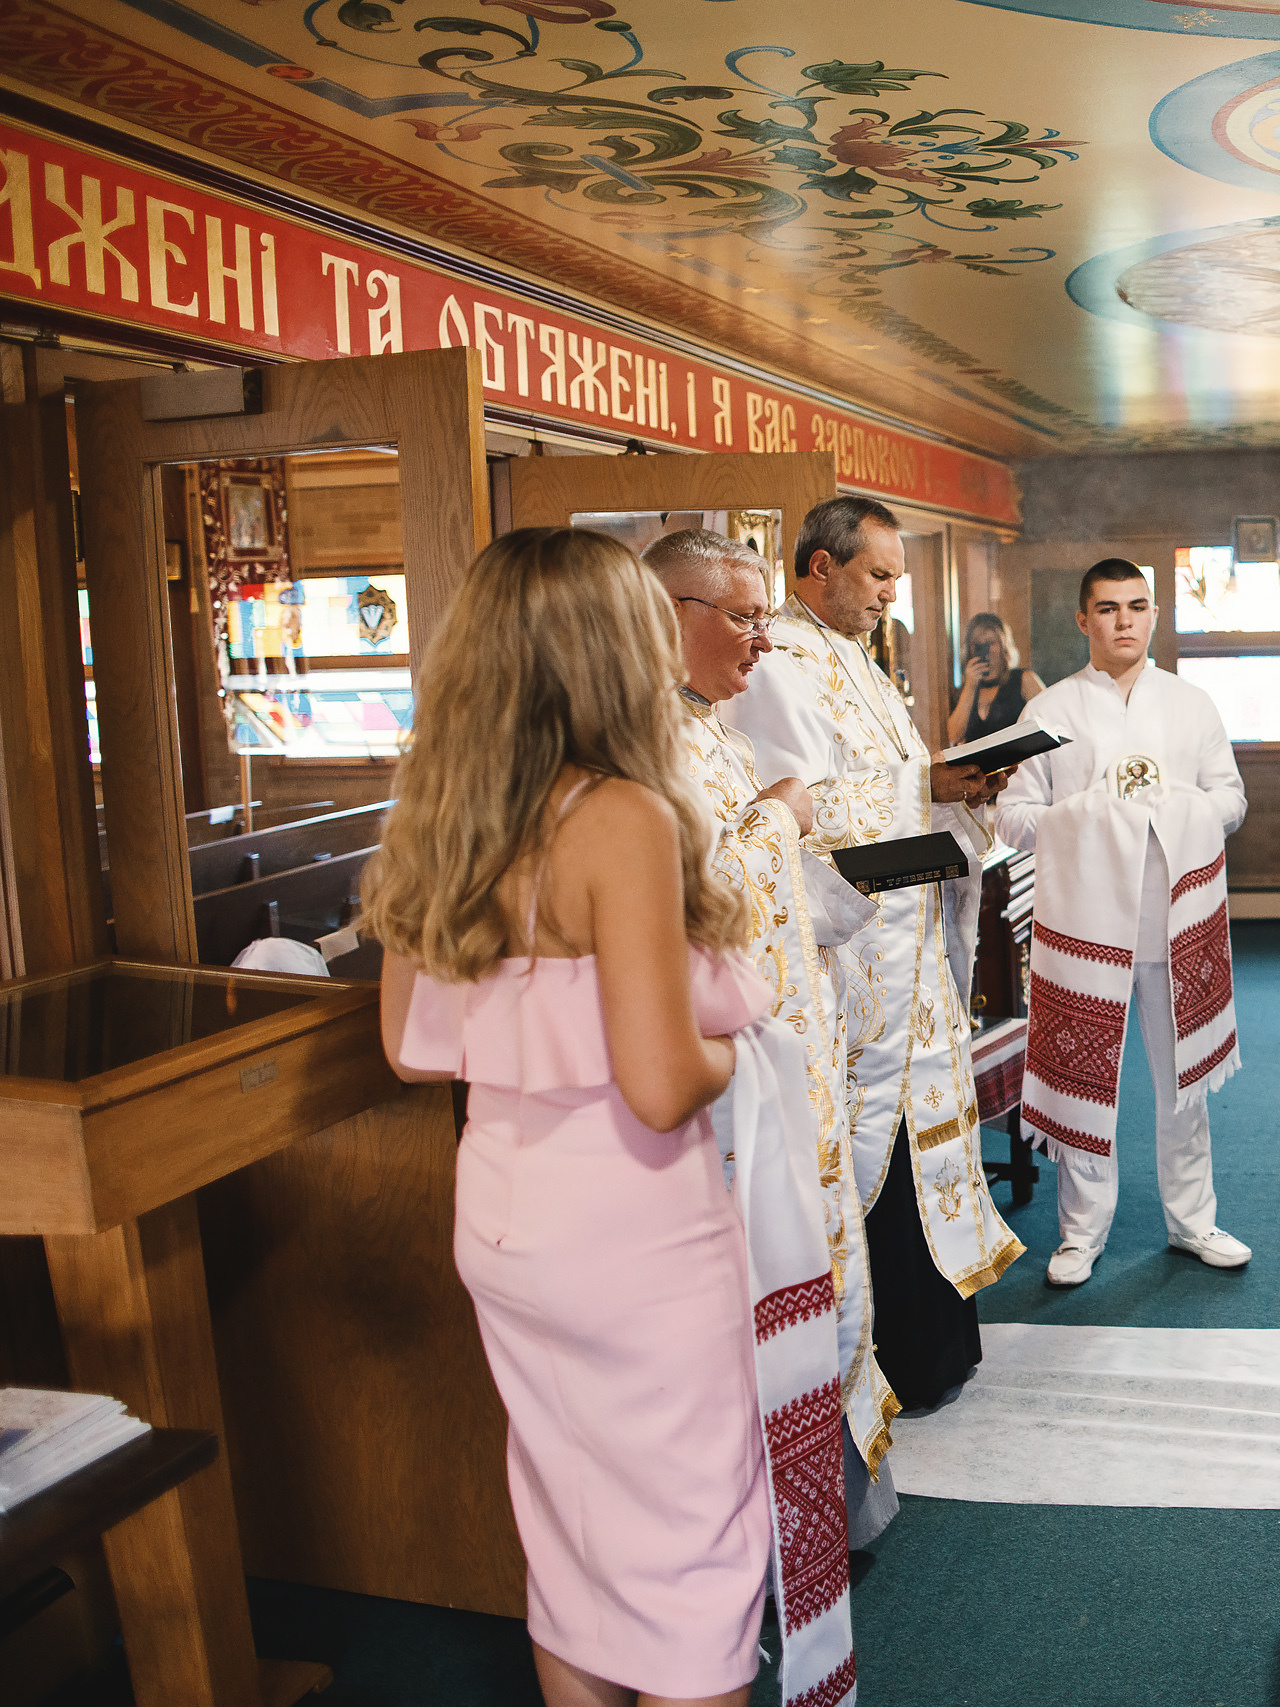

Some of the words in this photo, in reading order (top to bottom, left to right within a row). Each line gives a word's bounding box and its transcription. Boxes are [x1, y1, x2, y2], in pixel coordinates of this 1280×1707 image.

[321, 251, 404, 356] ТА
[712, 375, 733, 447] Я
[746, 391, 798, 454] ВАС
